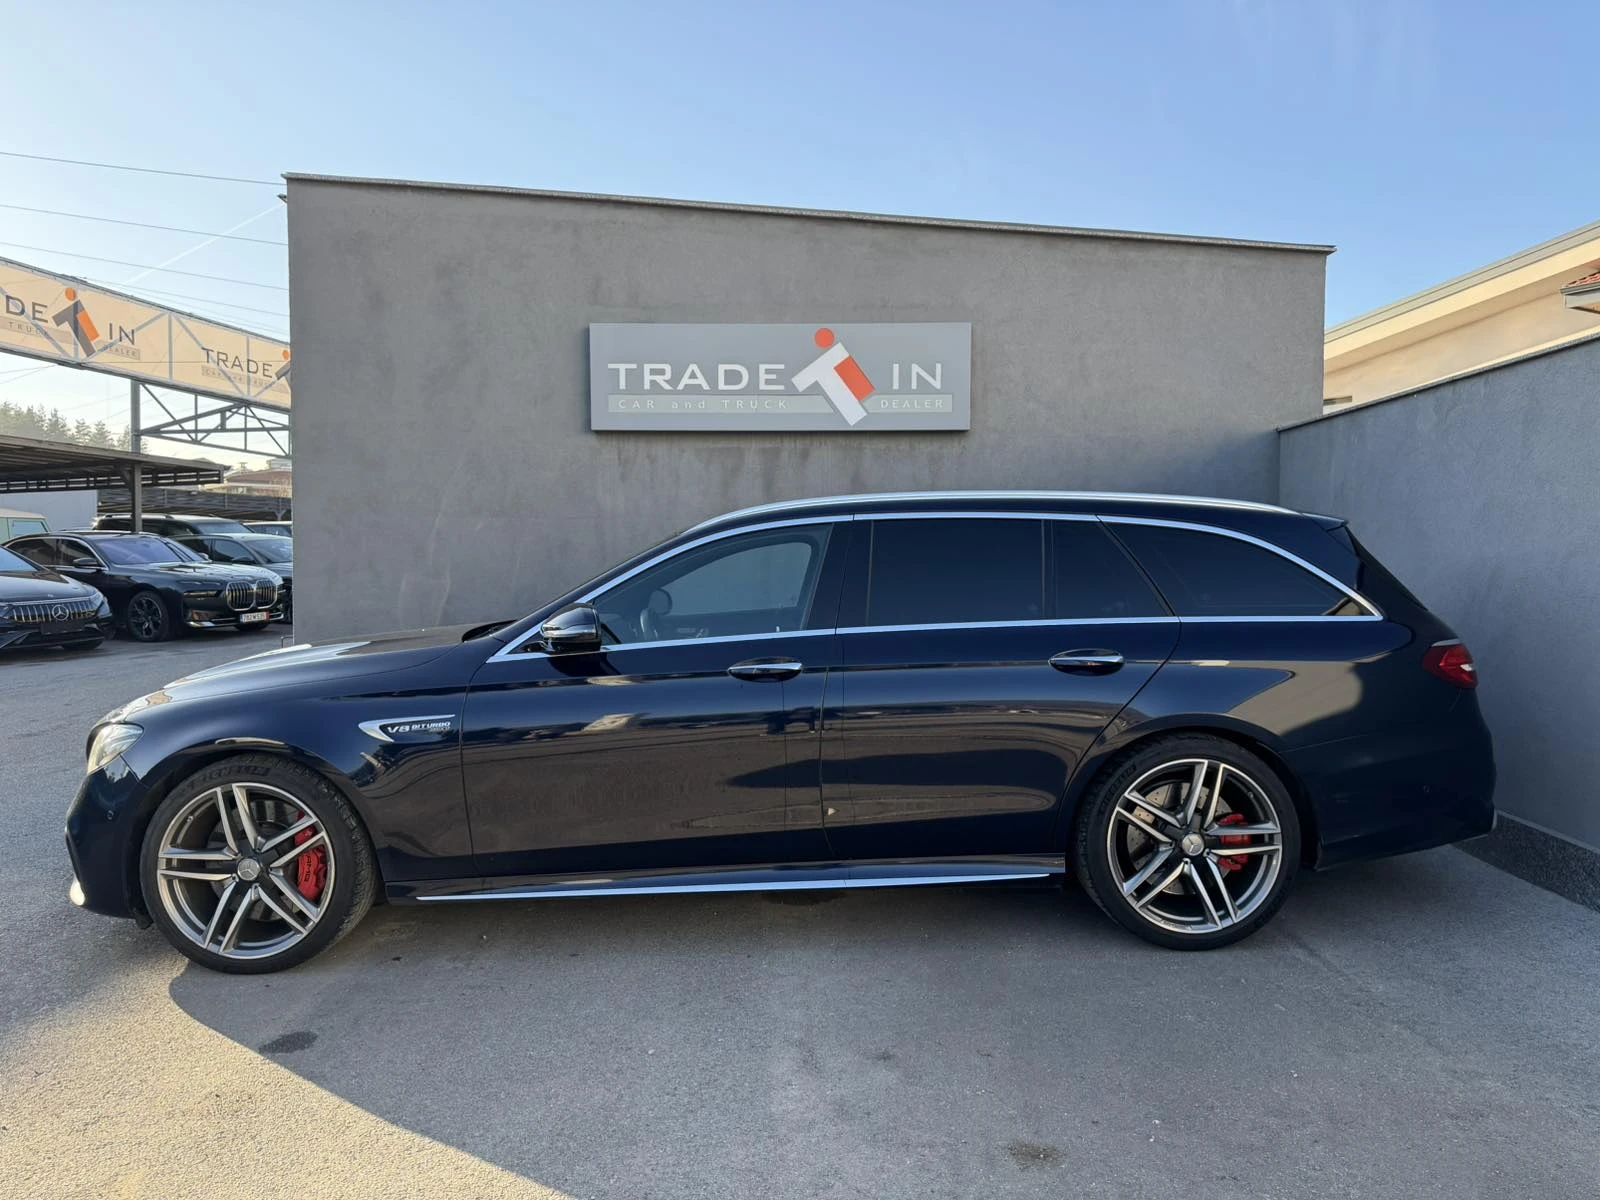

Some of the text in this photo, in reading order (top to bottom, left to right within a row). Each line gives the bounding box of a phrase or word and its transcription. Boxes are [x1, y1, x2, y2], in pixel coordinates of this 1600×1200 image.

[5, 294, 49, 323] DE
[109, 322, 135, 345] IN
[201, 347, 273, 378] TRADE
[608, 363, 785, 390] TRADE
[892, 363, 942, 390] IN
[618, 399, 944, 409] CAR and TRUCK DEALER
[387, 725, 410, 733] V8
[303, 855, 312, 882] AMG
